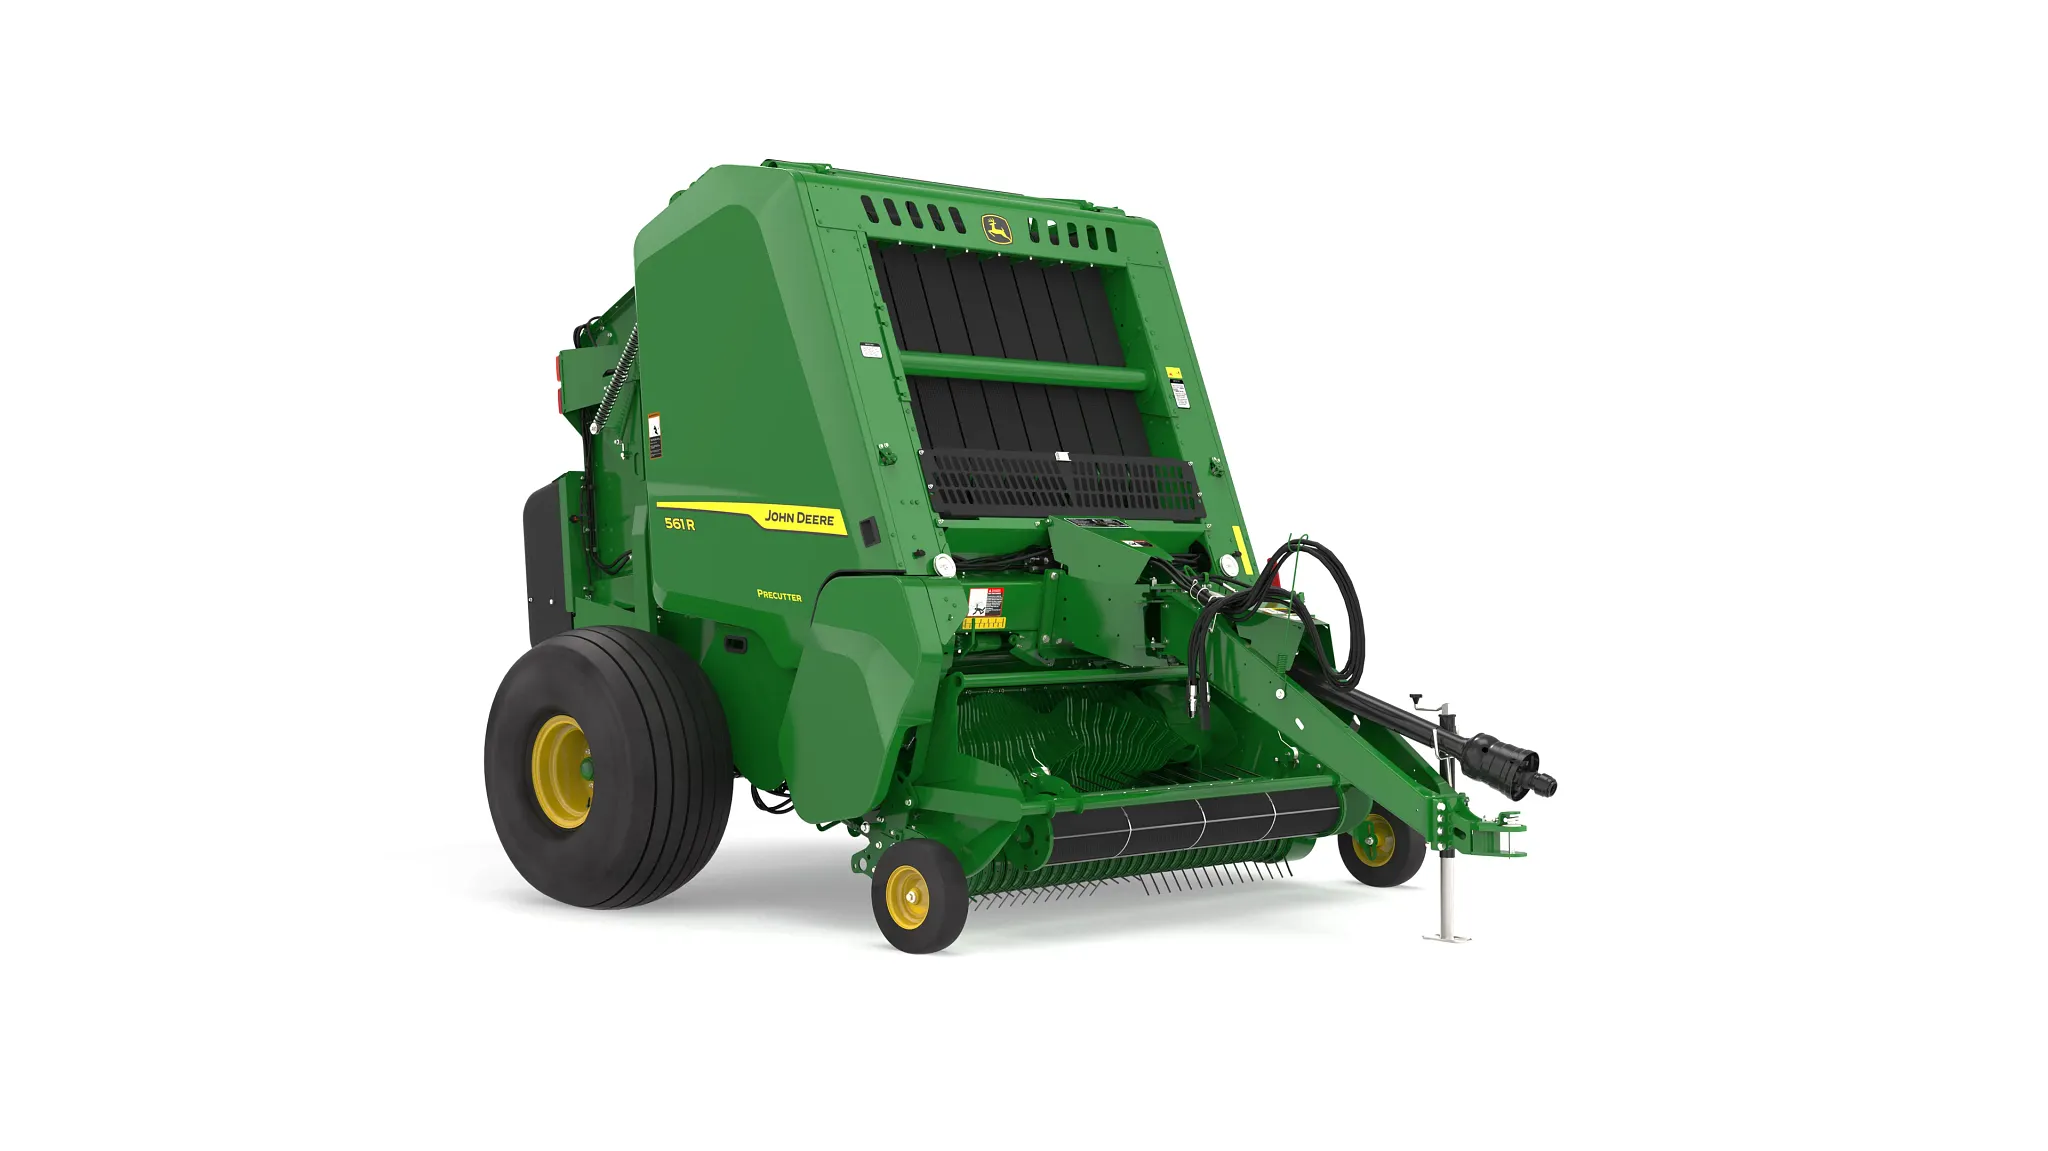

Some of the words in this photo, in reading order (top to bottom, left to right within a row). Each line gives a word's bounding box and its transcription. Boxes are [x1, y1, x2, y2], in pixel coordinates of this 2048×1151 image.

[764, 509, 795, 523] JOHN
[796, 511, 835, 526] DEERE
[756, 588, 803, 603] PRECUTTER
